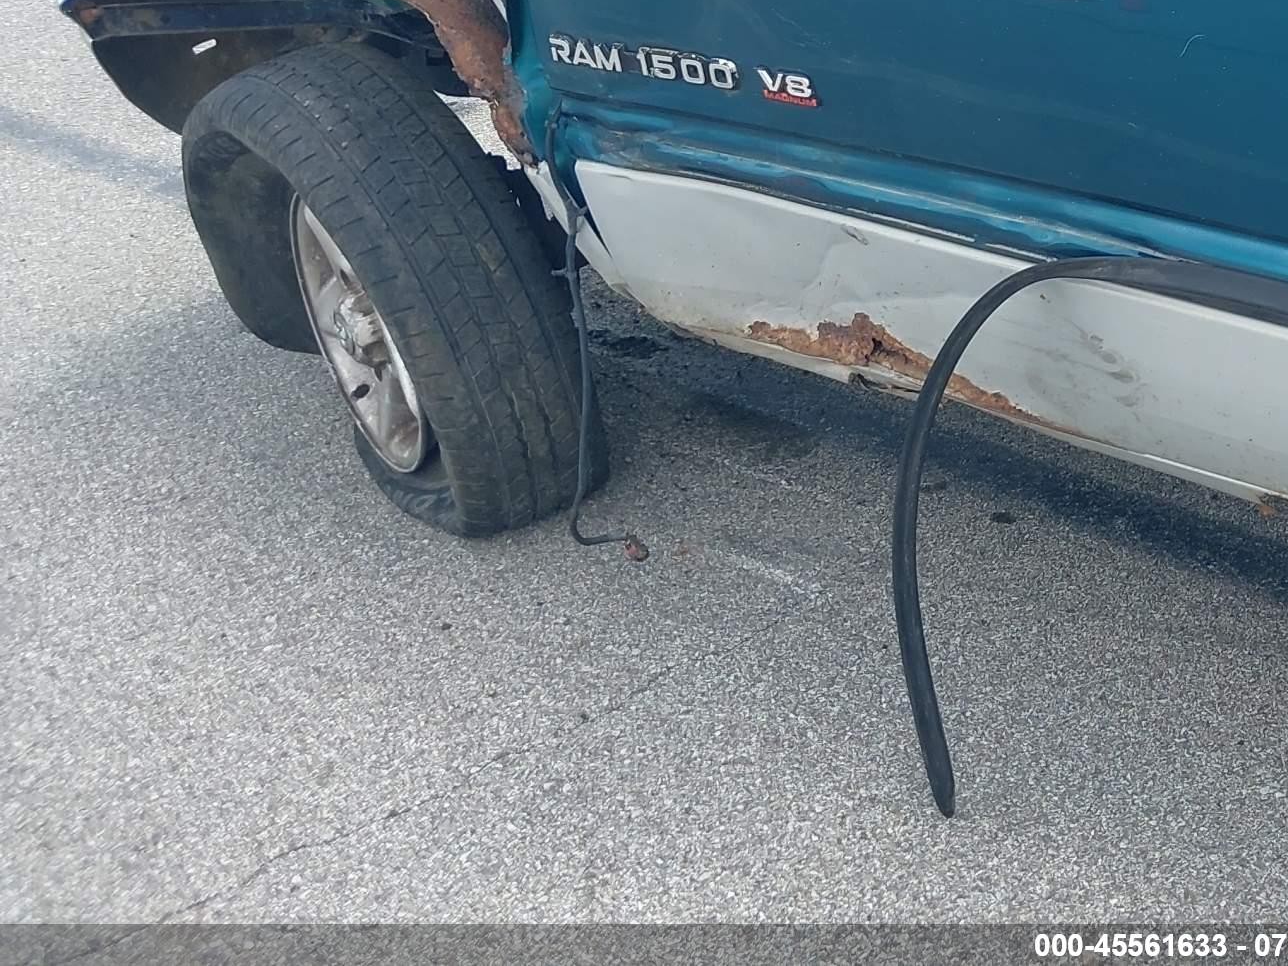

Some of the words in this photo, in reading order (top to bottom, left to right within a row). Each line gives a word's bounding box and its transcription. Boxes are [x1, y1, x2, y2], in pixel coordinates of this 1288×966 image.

[548, 36, 623, 73] RAM
[636, 48, 736, 90] 1500
[757, 69, 812, 98] V8
